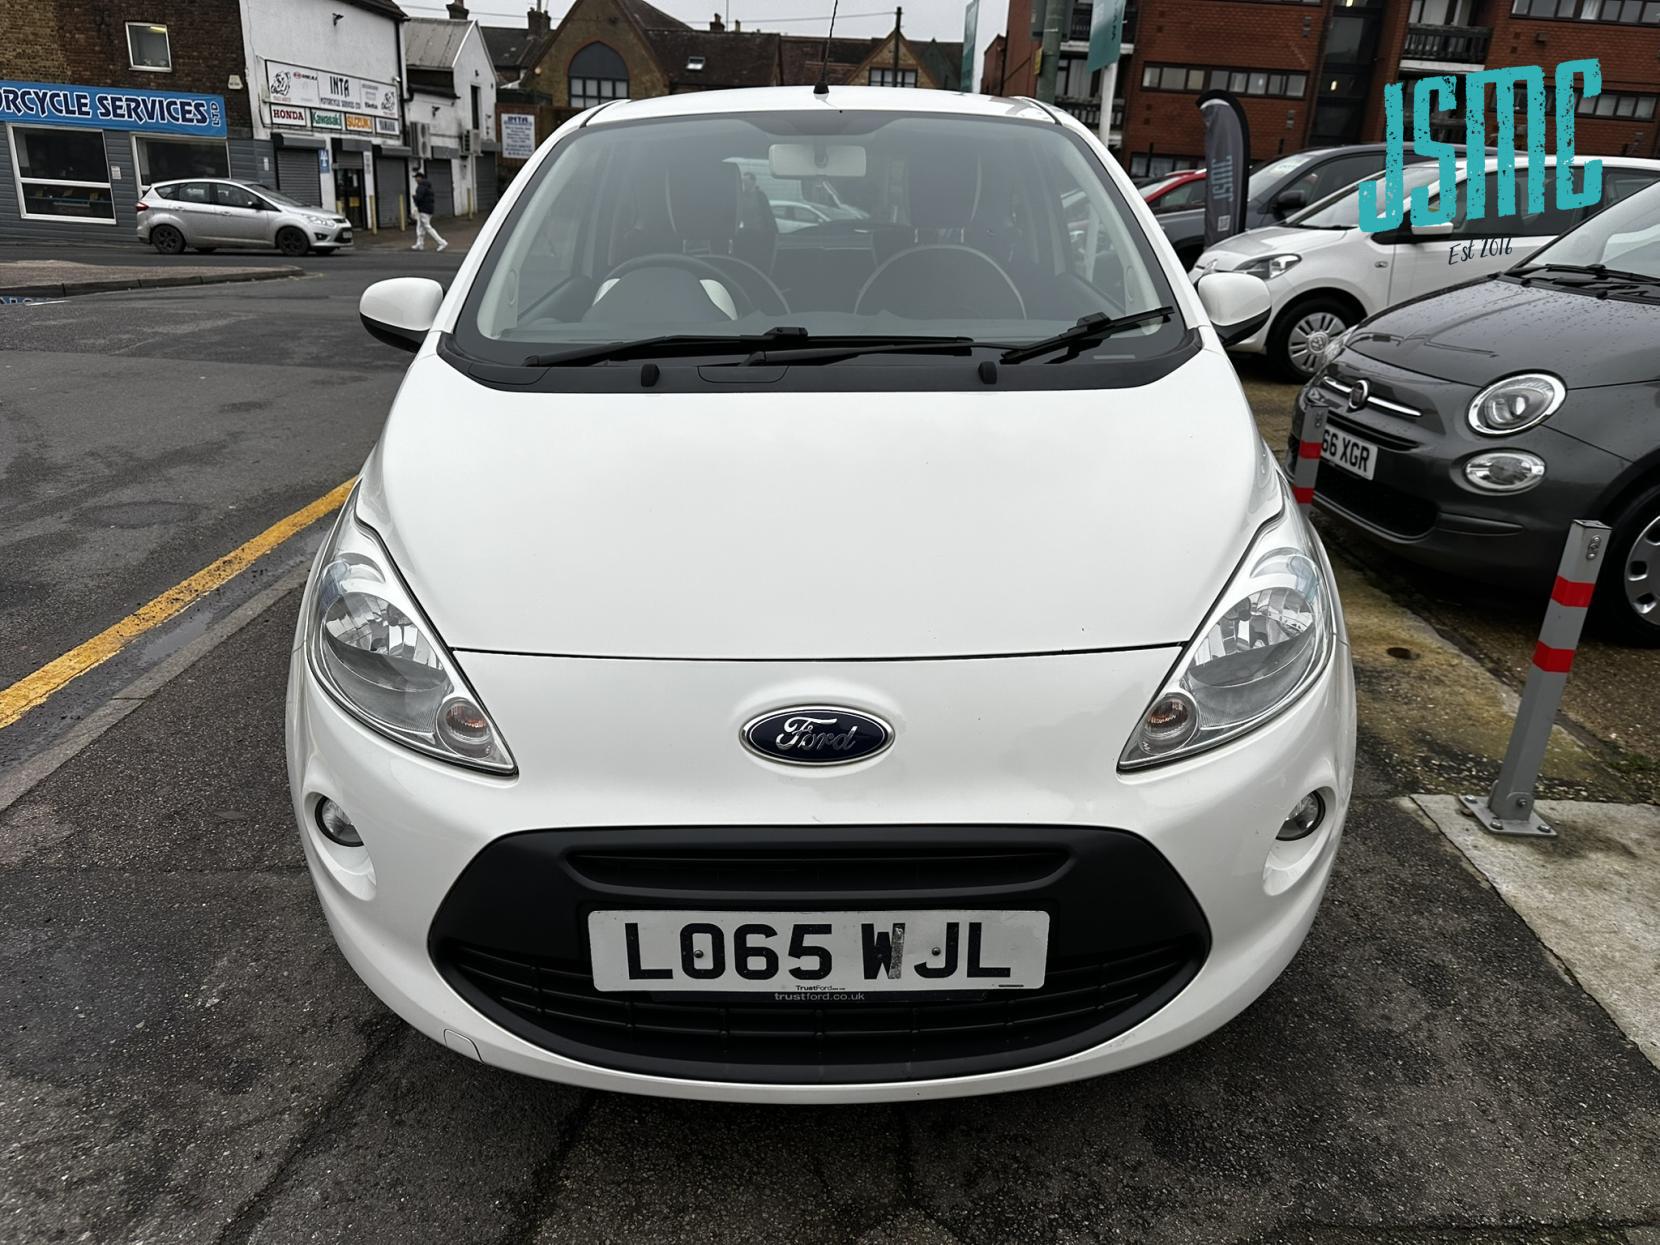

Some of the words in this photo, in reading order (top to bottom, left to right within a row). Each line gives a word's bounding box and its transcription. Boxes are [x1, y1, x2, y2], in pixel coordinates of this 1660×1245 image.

[329, 76, 350, 98] INTA
[96, 94, 208, 125] SERVICES
[210, 101, 221, 128] LTD
[273, 109, 304, 120] HONDA
[312, 111, 342, 127] Kawasaki
[347, 115, 372, 128] SUZUKI
[1211, 155, 1233, 202] JSMC
[1340, 437, 1370, 473] XGR
[776, 716, 858, 751] Ford
[624, 922, 833, 980] LO65
[860, 922, 1012, 980] WJL
[774, 992, 865, 1001] trustford.co.uk
